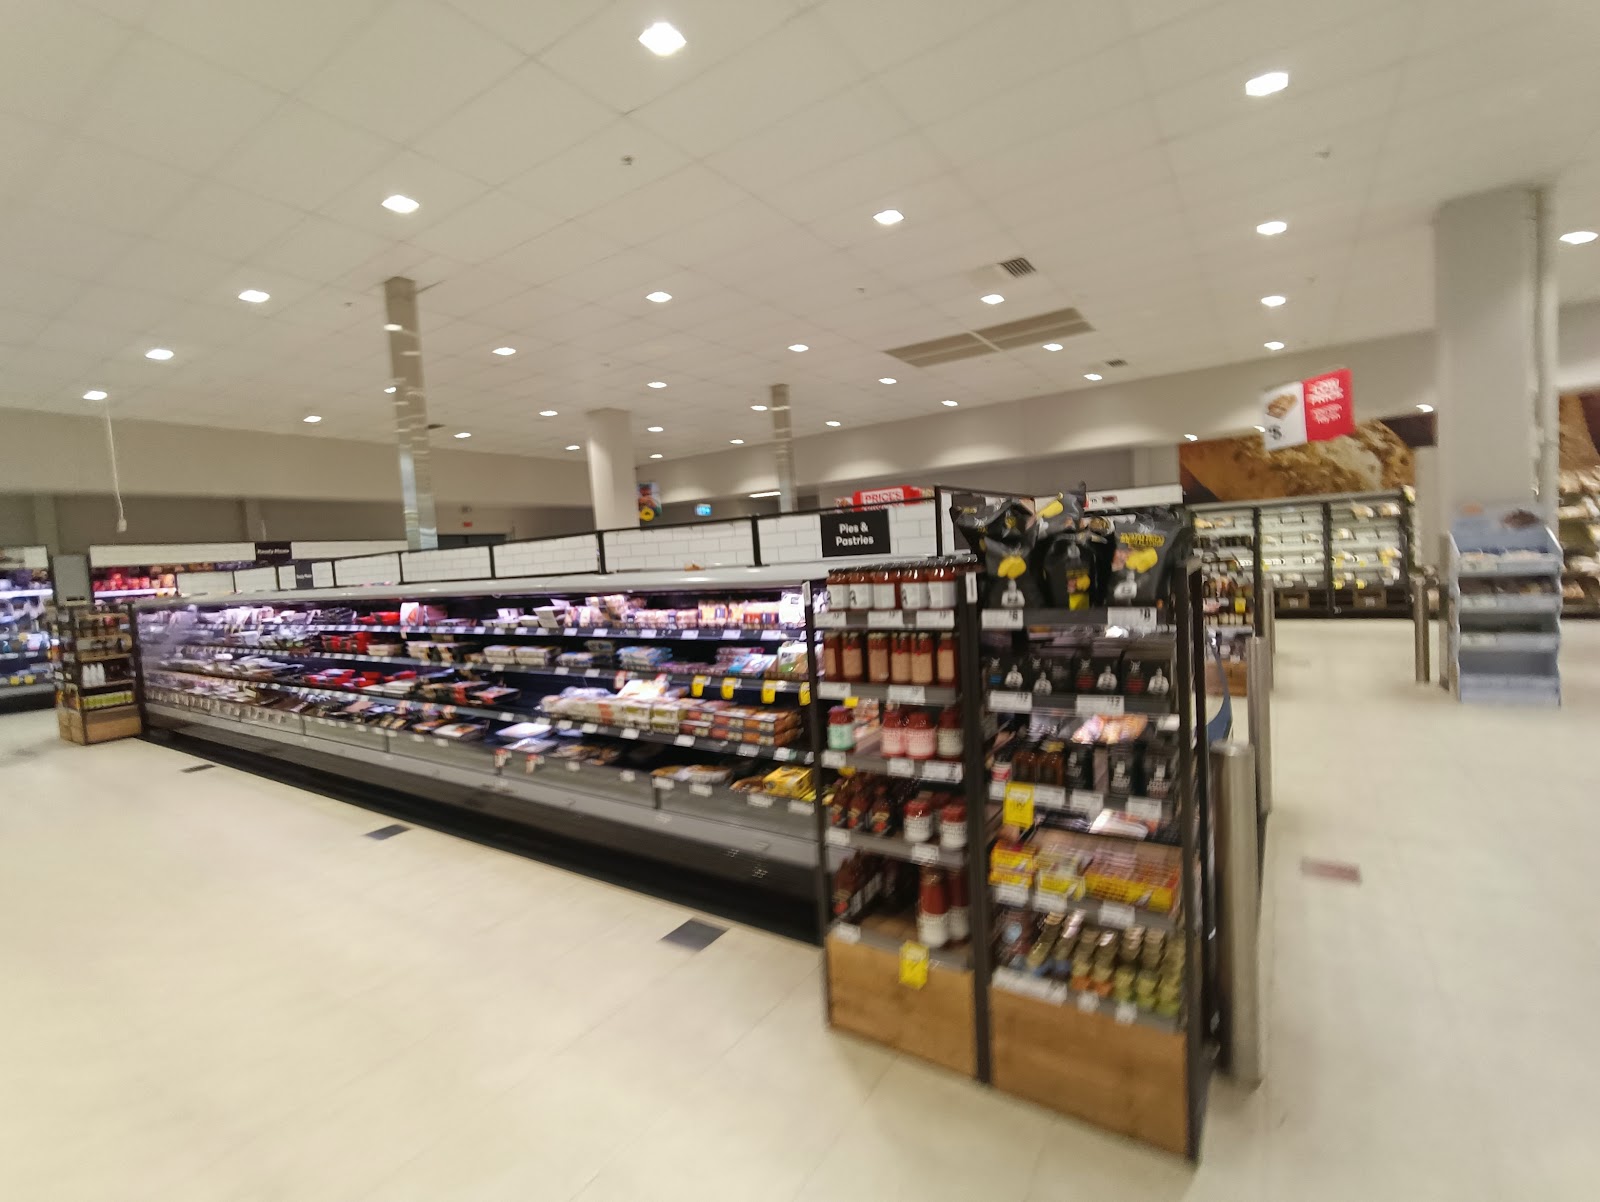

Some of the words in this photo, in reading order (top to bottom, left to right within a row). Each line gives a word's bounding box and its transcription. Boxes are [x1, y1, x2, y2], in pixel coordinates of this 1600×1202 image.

[865, 491, 902, 503] PRICES
[839, 523, 859, 534] Pies
[860, 521, 869, 533] &
[835, 534, 875, 547] Pastries
